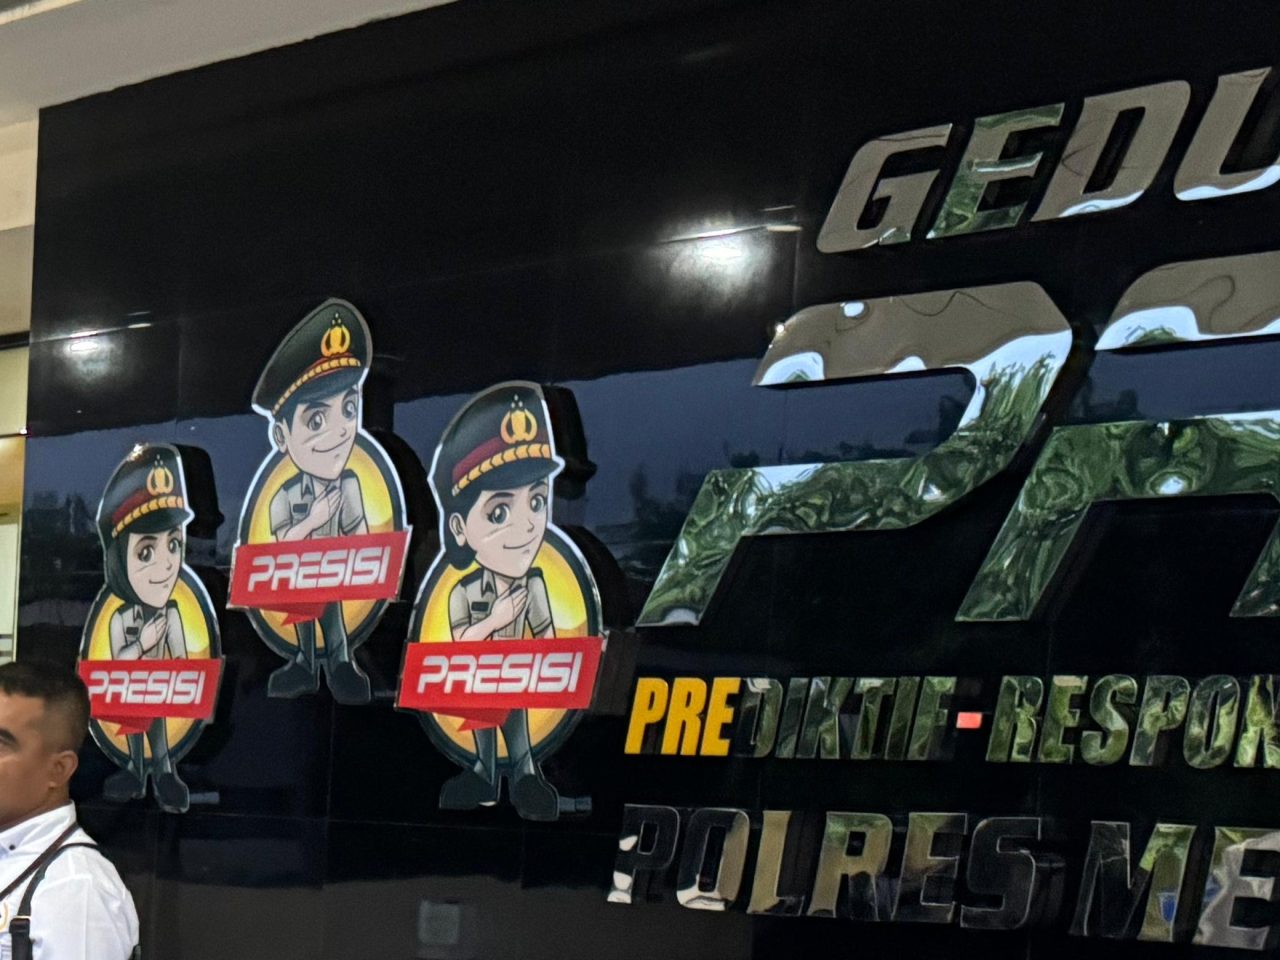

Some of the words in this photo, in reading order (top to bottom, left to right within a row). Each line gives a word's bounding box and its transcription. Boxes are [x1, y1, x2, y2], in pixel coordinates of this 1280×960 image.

[247, 546, 391, 593] PRESISI
[88, 670, 206, 705] PRESISI
[417, 651, 582, 695] PRESISI
[606, 803, 1042, 930] POLRES
[1068, 820, 1280, 950] ME
